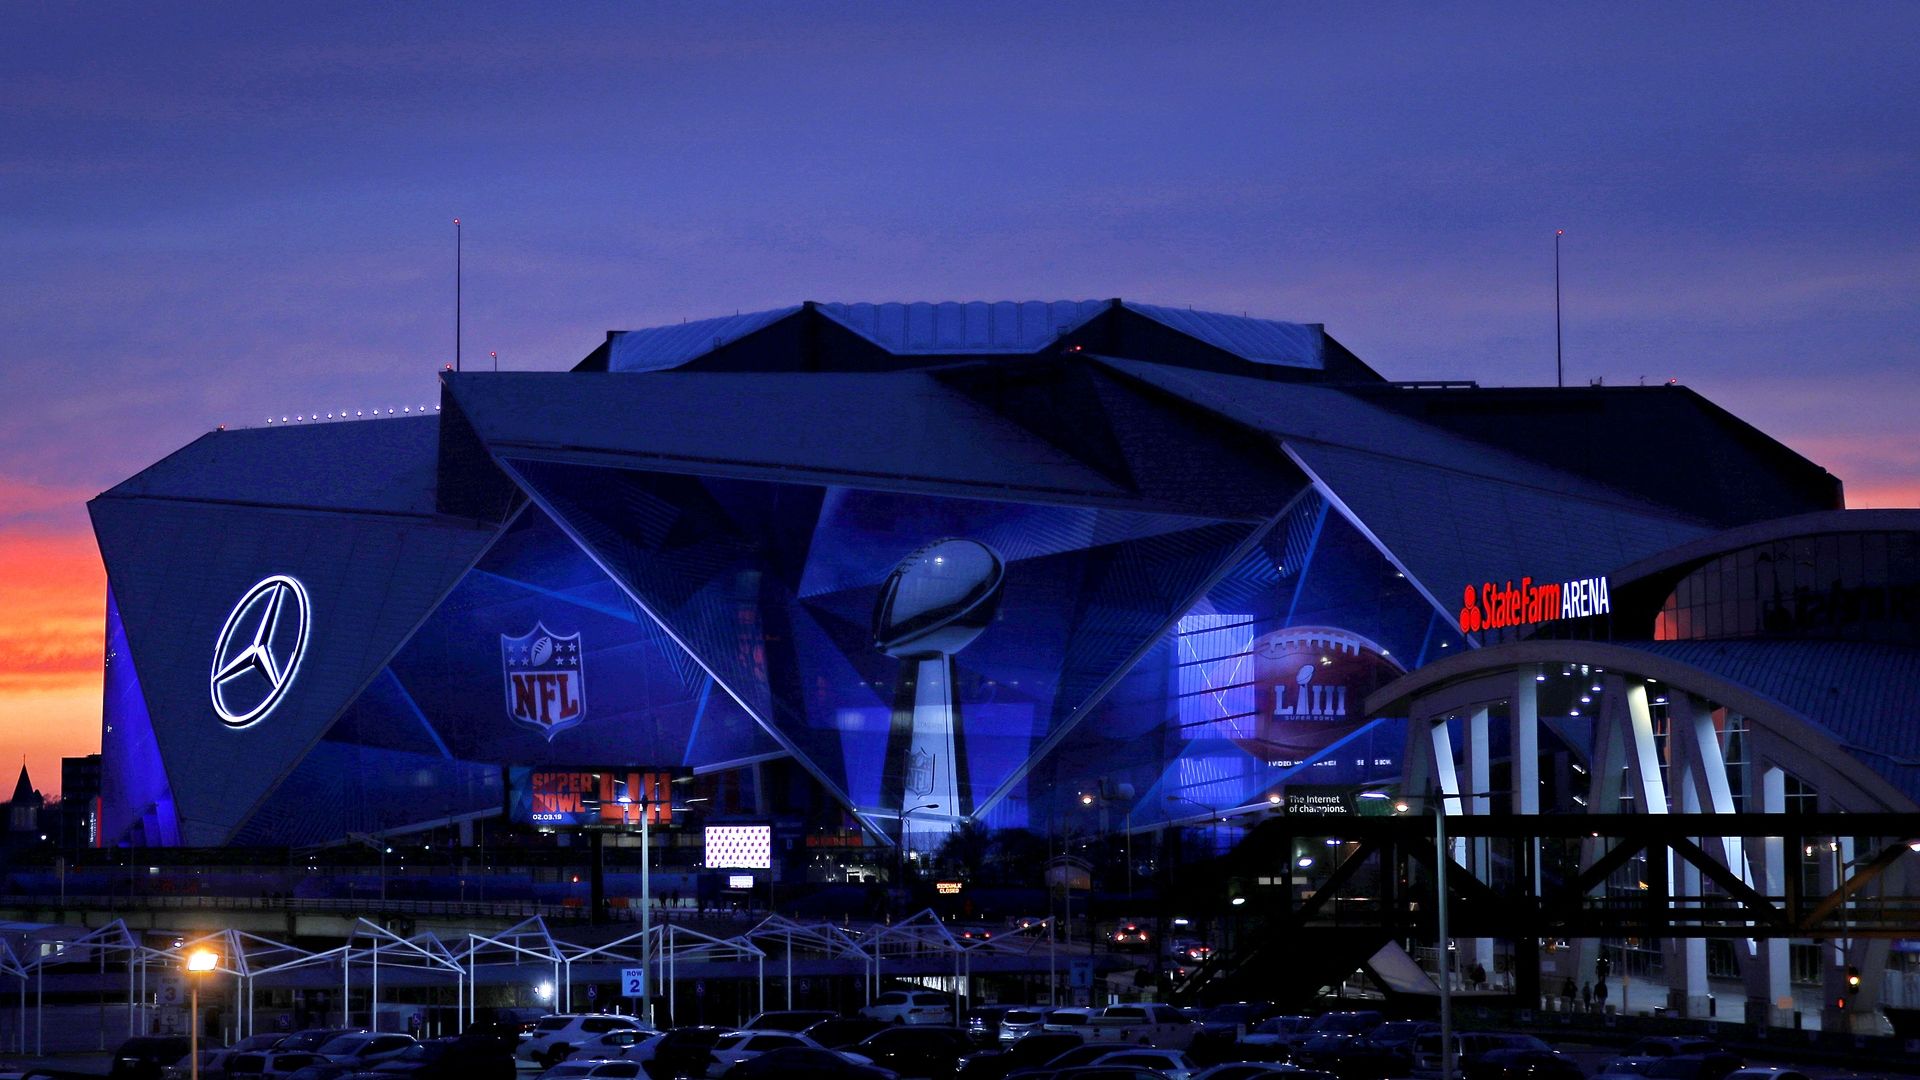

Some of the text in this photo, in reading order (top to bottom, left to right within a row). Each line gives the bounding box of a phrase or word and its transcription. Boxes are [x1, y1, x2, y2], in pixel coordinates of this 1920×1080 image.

[1562, 576, 1610, 620] ARENA
[512, 673, 578, 725] NFL
[532, 773, 593, 793] SUPER
[532, 794, 586, 813] BOWL
[1289, 795, 1340, 804] The Internet
[1289, 805, 1298, 813] of
[165, 986, 177, 1001] 3
[630, 979, 640, 992] 2
